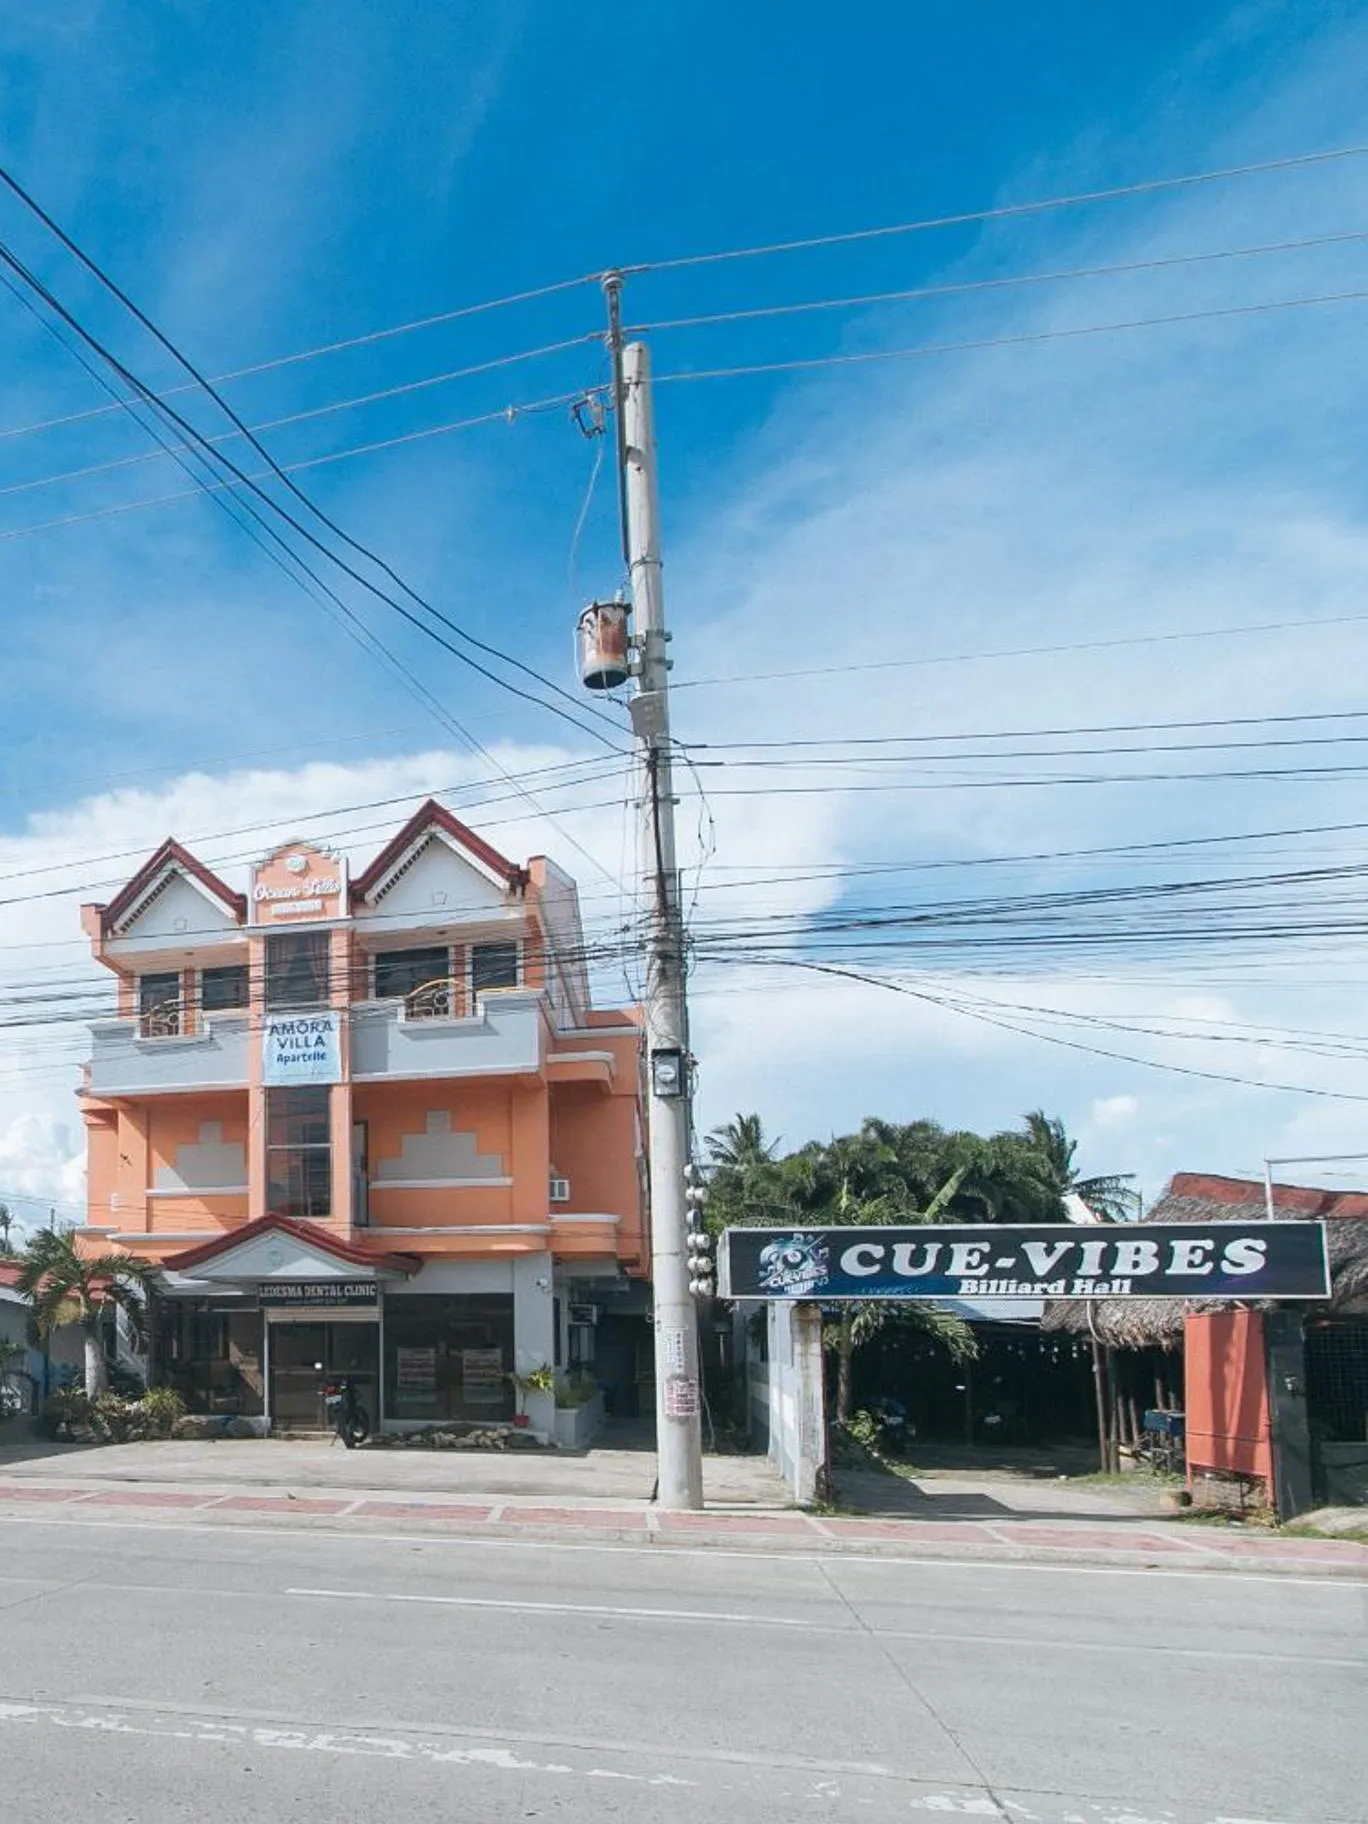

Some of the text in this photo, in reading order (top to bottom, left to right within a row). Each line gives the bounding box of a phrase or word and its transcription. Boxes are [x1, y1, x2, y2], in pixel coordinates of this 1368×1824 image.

[276, 1035, 326, 1050] VILLA
[276, 1051, 327, 1066] Apartelle
[839, 1238, 1268, 1277] CUE-VIBES
[259, 1283, 377, 1298] LEDESMA DENTAL CLINIC
[957, 1278, 1132, 1295] Billiard Hall
